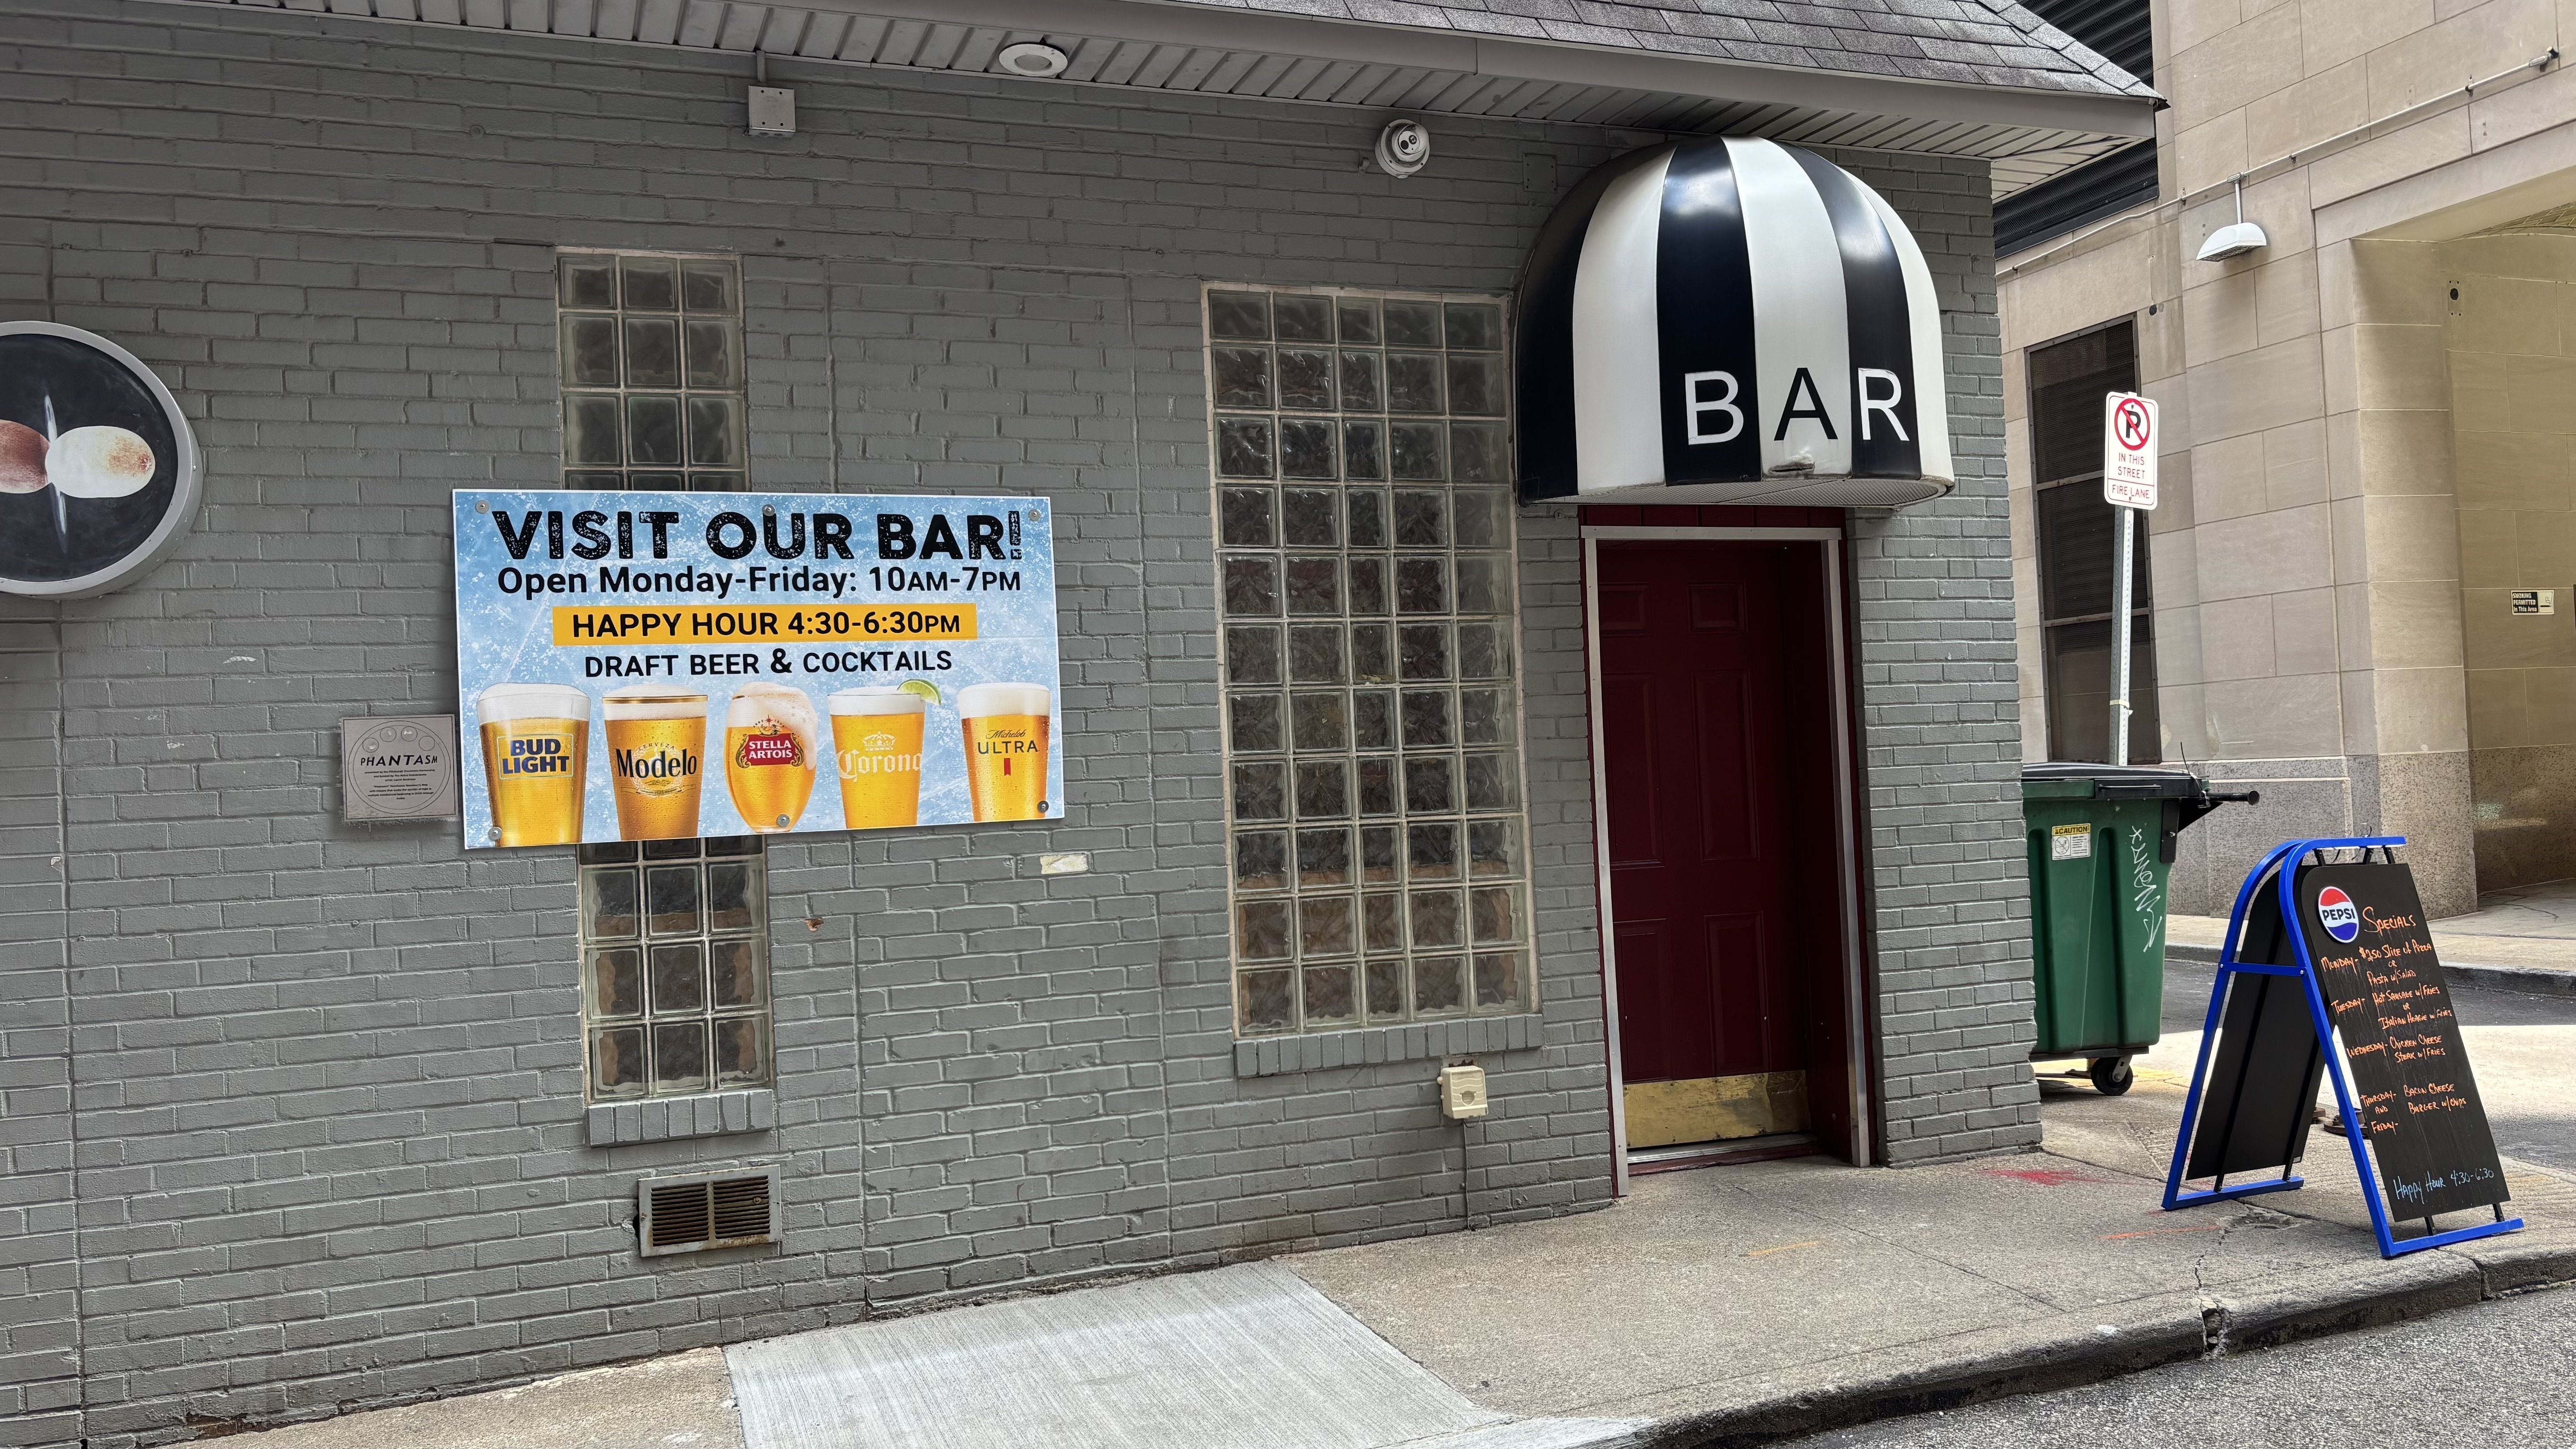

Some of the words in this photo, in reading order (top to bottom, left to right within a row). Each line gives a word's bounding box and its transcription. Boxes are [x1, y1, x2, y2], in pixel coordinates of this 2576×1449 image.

[1685, 368, 1910, 445] BAR
[2119, 452, 2125, 462] IN
[2129, 454, 2144, 465] THIS
[2118, 466, 2145, 479] STREET
[2112, 484, 2128, 495] FIRE
[2130, 487, 2150, 499] LANE
[492, 511, 679, 560] VISIT
[706, 511, 854, 560] OUR
[877, 511, 1022, 560] BAR!
[498, 567, 586, 600] Open
[600, 566, 856, 599] Monday-Friday:
[869, 566, 1021, 591] 10AM-7PM
[573, 613, 681, 637] HAPPY
[693, 612, 778, 635] HOUR
[788, 612, 959, 635] 4:30-6:30PM
[585, 655, 679, 677] DRAFT
[690, 653, 760, 675] BEER
[771, 648, 792, 673] &
[803, 650, 952, 672] COCKTAILS
[986, 729, 1026, 739] Michelob
[511, 739, 561, 756] BUD
[639, 742, 674, 750] CERVEZA
[749, 740, 791, 749] STELLA
[977, 740, 1038, 754] ULTRA
[361, 754, 437, 766] PHANTASM
[749, 750, 792, 759] ARTOIS
[502, 756, 569, 774] LIGHT
[616, 748, 697, 778] Modelo
[2322, 908, 2355, 921] PEPSI
[2451, 1168, 2494, 1187] 4:30-6:30
